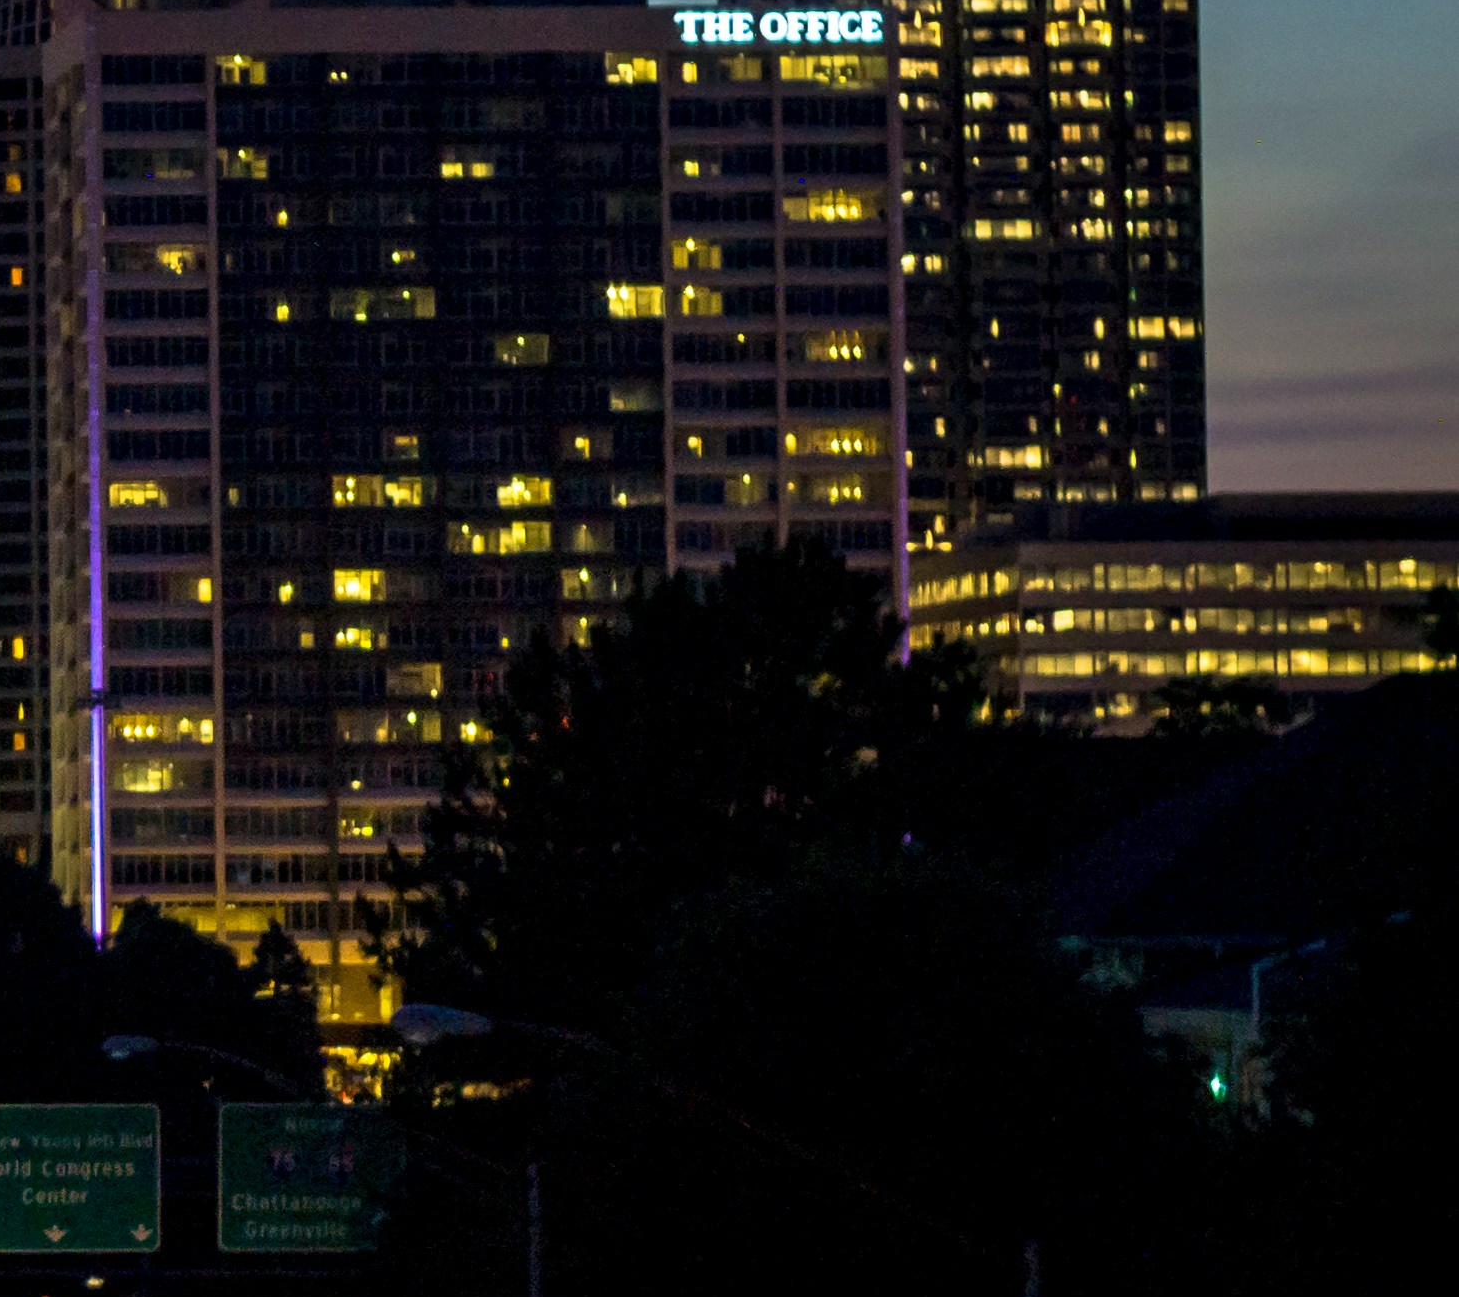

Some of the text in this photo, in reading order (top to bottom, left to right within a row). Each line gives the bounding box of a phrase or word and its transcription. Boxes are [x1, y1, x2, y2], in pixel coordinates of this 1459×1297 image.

[674, 10, 884, 43] THE OFFICE
[41, 1159, 136, 1181] Congress
[21, 1187, 89, 1205] Center
